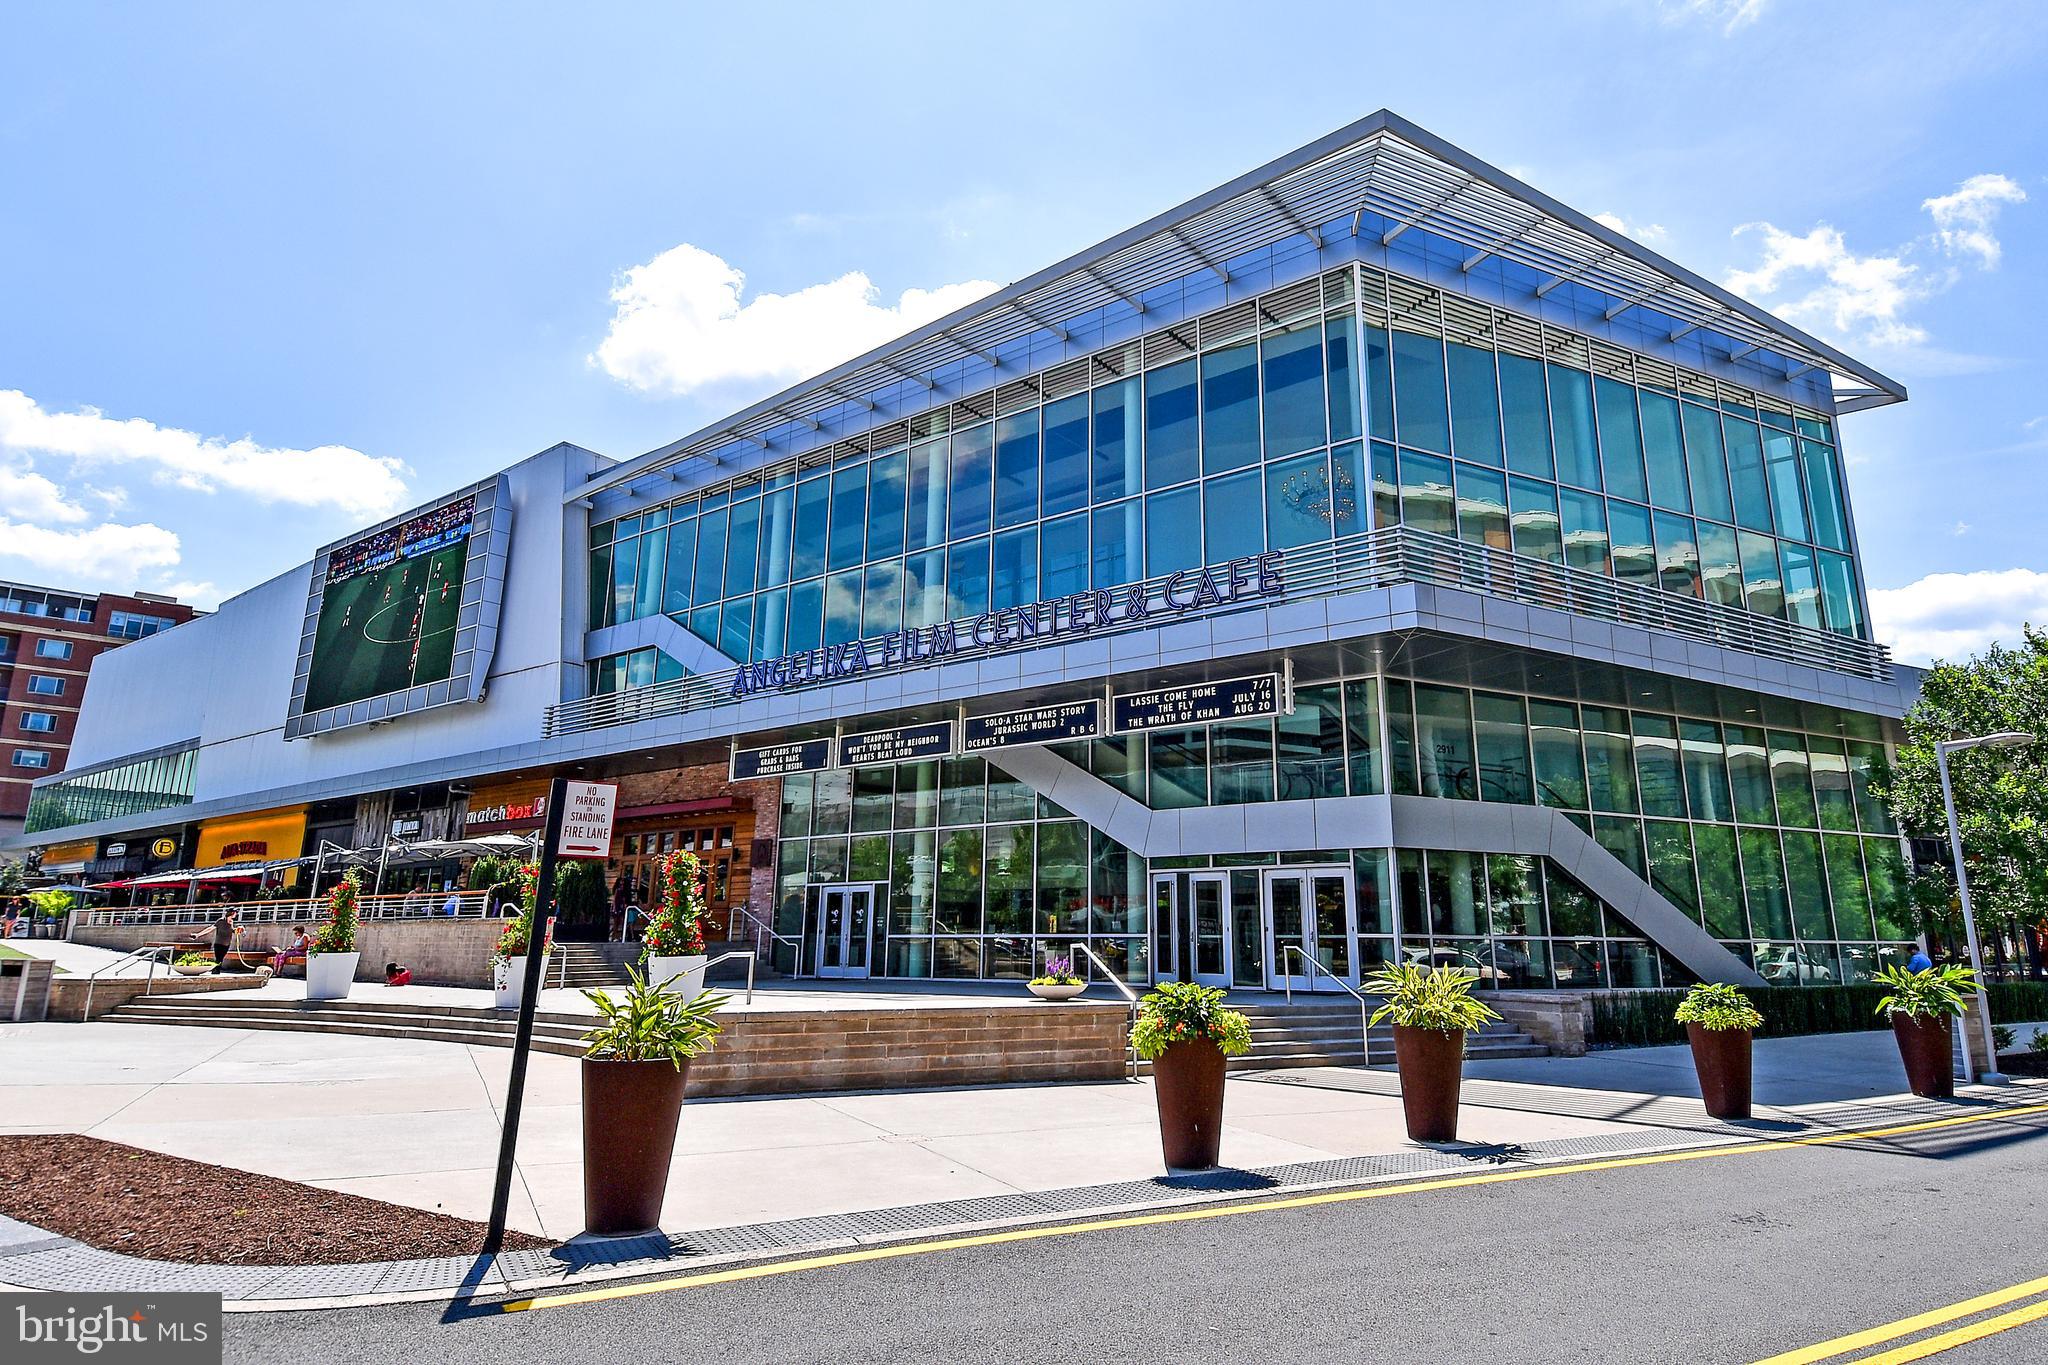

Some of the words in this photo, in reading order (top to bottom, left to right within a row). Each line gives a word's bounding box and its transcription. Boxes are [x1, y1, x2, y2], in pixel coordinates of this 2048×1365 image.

[730, 640, 868, 696] ANGELIKA
[881, 620, 956, 668] FILM
[971, 588, 1112, 648] CENTER
[1124, 585, 1148, 620] &
[1163, 550, 1283, 611] CAFE
[1130, 694, 1160, 707] LASSIE
[1164, 690, 1188, 702] COME
[1192, 686, 1216, 698] HOME
[1252, 678, 1271, 690] 7/7
[1158, 703, 1173, 713] THE
[1178, 700, 1194, 711] FLY
[1232, 691, 1256, 704] JULY
[1261, 690, 1271, 700] 16
[1014, 713, 1033, 724] STAR
[1037, 710, 1057, 720] WARS
[1060, 706, 1086, 717] STORY
[1128, 718, 1143, 728] THE
[1148, 713, 1176, 726] WRATH
[1180, 710, 1192, 720] OF
[1197, 707, 1220, 718] KHAN
[1234, 702, 1254, 714] AUG
[1258, 701, 1270, 712] 20
[994, 723, 1028, 736] JURASSIC
[1032, 720, 1056, 730] WORLD
[1060, 718, 1064, 726] 2
[1071, 726, 1076, 735] R
[1089, 724, 1094, 732] G
[848, 745, 866, 754] WON'T
[869, 743, 881, 752] YOU
[884, 741, 892, 750] BE
[908, 735, 939, 747] NEIGHBOR
[864, 732, 894, 744] DEADPOOL
[968, 736, 997, 748] OCEAN'S
[772, 748, 789, 756] CARDS
[852, 752, 874, 762] HEARTS
[877, 750, 893, 760] BEAT
[896, 748, 912, 757] LOUD
[1436, 744, 1455, 755] 2911
[786, 754, 799, 762] DADS
[757, 764, 783, 775] PURCHASE
[786, 762, 803, 770] INSIDE
[587, 786, 597, 796] NO
[575, 796, 605, 806] PARKING
[466, 804, 532, 824] matchbox
[571, 812, 606, 823] STANDING
[564, 825, 584, 838] FIRE
[587, 827, 608, 839] LANE
